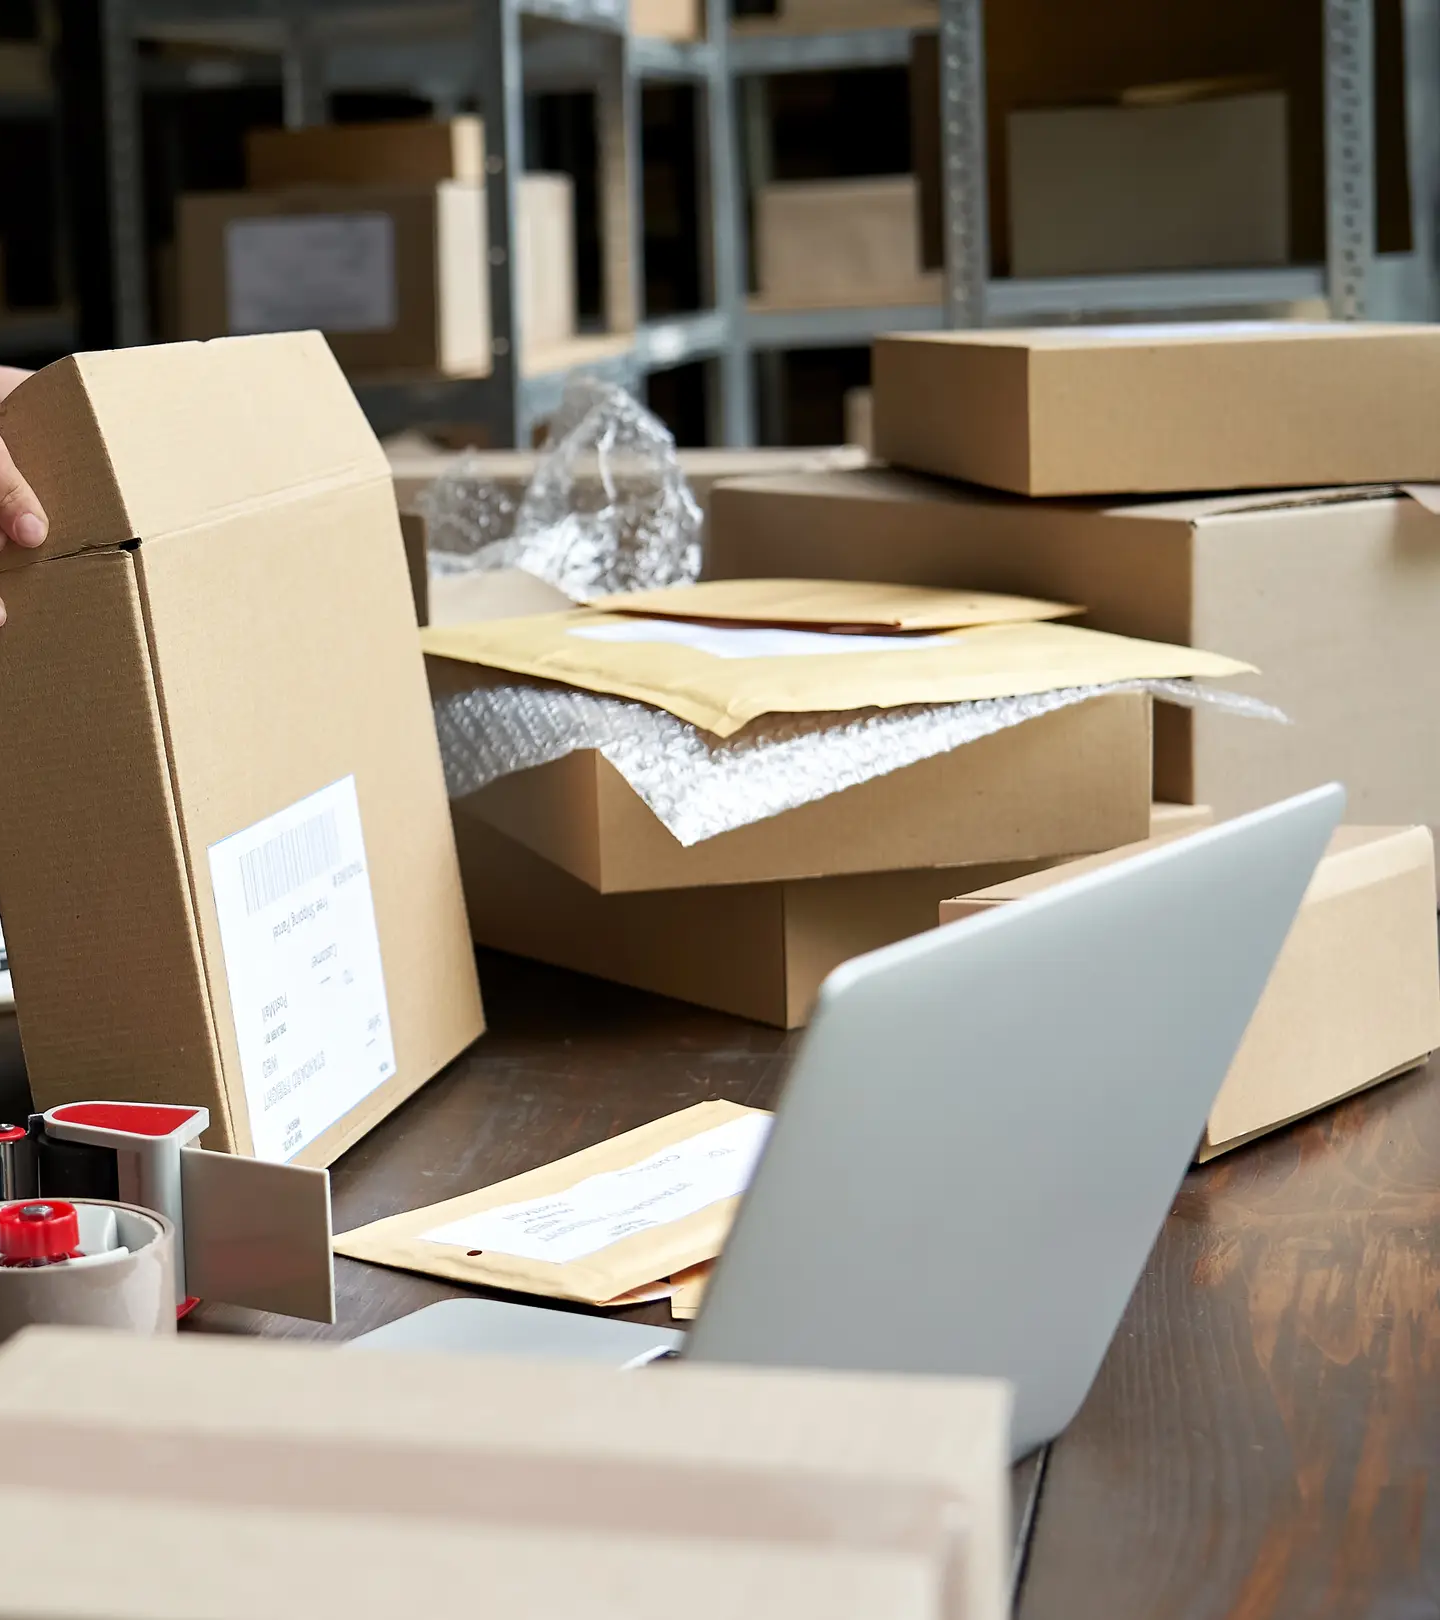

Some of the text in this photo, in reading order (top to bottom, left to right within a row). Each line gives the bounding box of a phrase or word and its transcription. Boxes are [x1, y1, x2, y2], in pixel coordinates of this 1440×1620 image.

[272, 911, 291, 943] Parcel
[291, 903, 316, 929] Shipping
[311, 942, 338, 969] Customer
[261, 991, 288, 1024] PostMail
